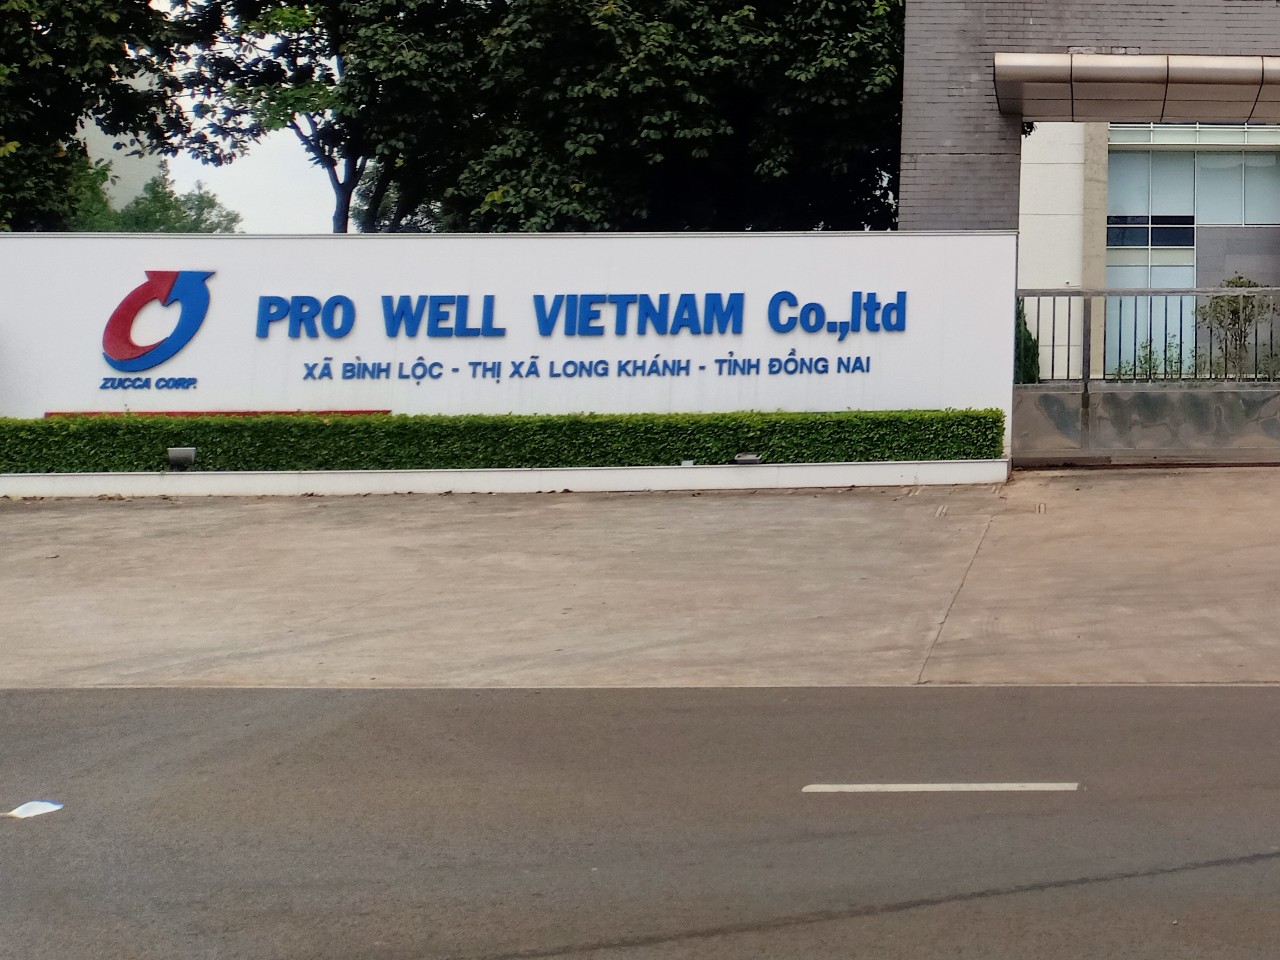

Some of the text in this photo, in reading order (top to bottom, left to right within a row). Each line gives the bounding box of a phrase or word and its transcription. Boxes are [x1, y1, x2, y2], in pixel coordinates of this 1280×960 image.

[255, 290, 907, 342] PRO WELL VIETNAM Co.,ltd
[98, 376, 198, 390] ZUCCA CORP.
[303, 356, 333, 380] XÃ
[341, 355, 392, 380] BÌNH
[397, 355, 444, 386] LỘC
[468, 360, 502, 384] THỊ
[509, 355, 540, 378] XÃ
[549, 359, 609, 378] LONG
[617, 353, 691, 378] KHÁNH
[714, 350, 761, 377] TỈNH
[836, 356, 871, 374] NAI
